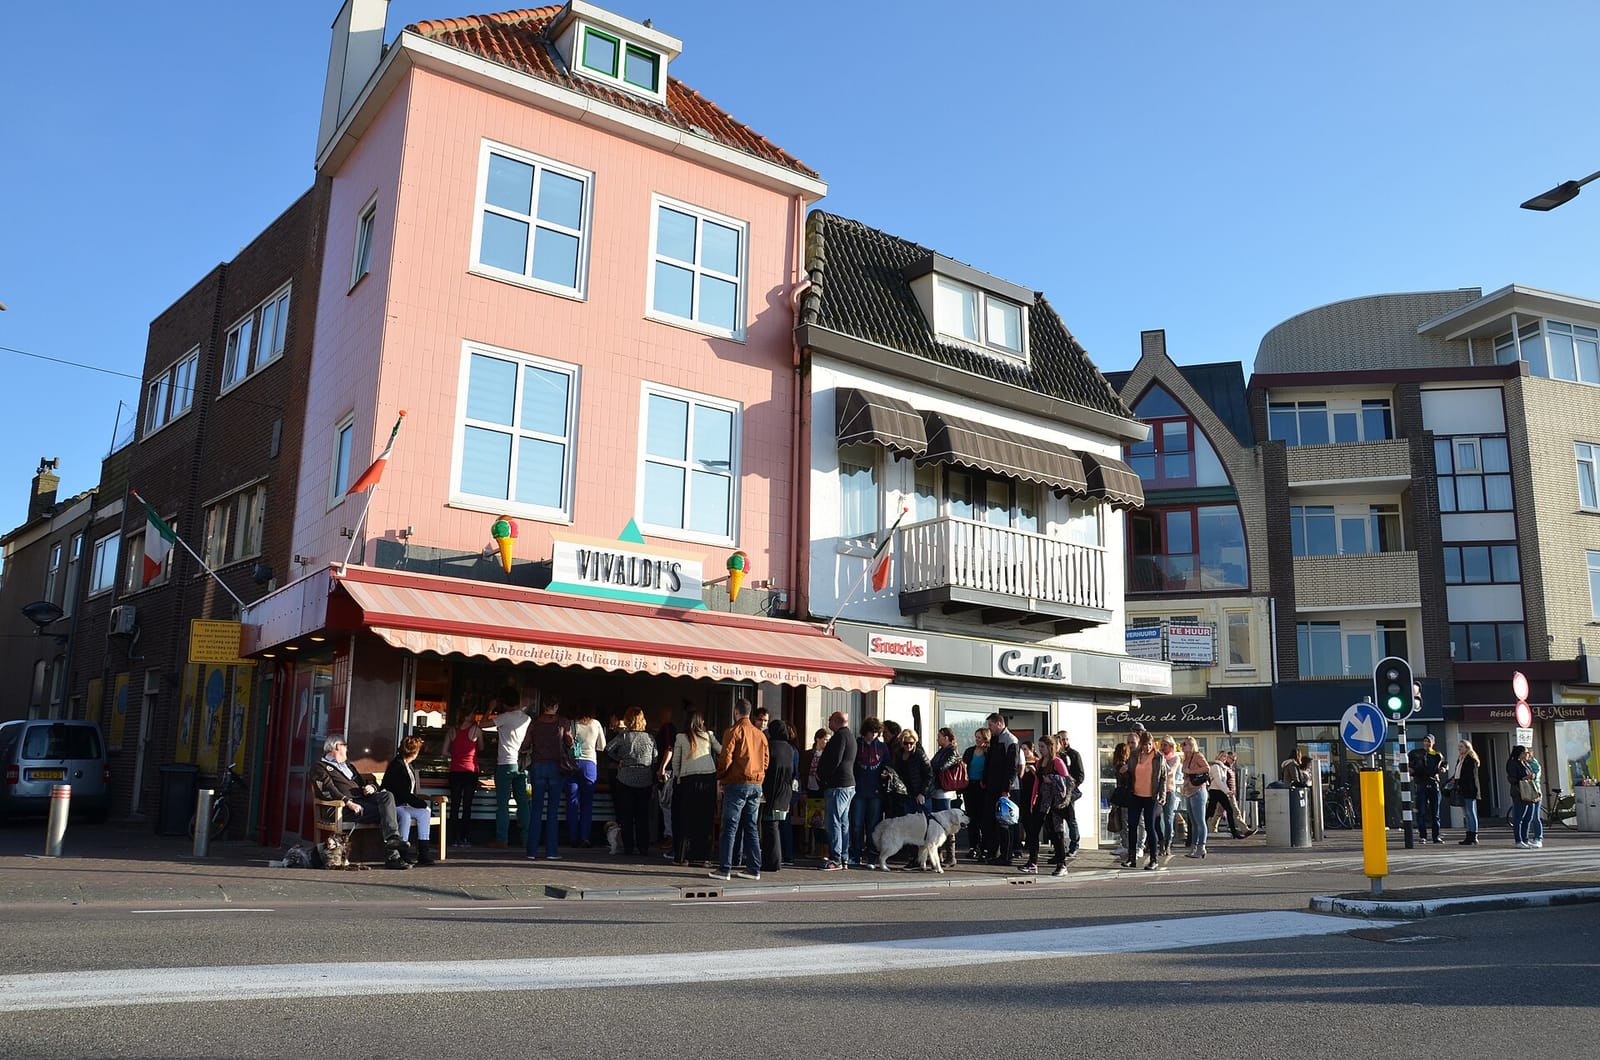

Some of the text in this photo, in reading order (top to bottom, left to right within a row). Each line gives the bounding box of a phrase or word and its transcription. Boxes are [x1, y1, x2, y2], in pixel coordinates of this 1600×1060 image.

[576, 549, 682, 592] VIVALDI'S
[1170, 627, 1210, 636] TE HUUR
[870, 637, 925, 657] Snacks
[488, 643, 572, 662] Ambachtelijk
[575, 651, 631, 667] Italiaans
[634, 657, 648, 670] ijs
[664, 660, 700, 673] Softijs
[711, 665, 742, 676] Slush
[760, 669, 781, 680] Cool
[784, 673, 817, 683] drinks
[1116, 711, 1156, 722] Onder
[1160, 712, 1176, 722] de
[1489, 705, 1585, 720] Réside Le Mistral
